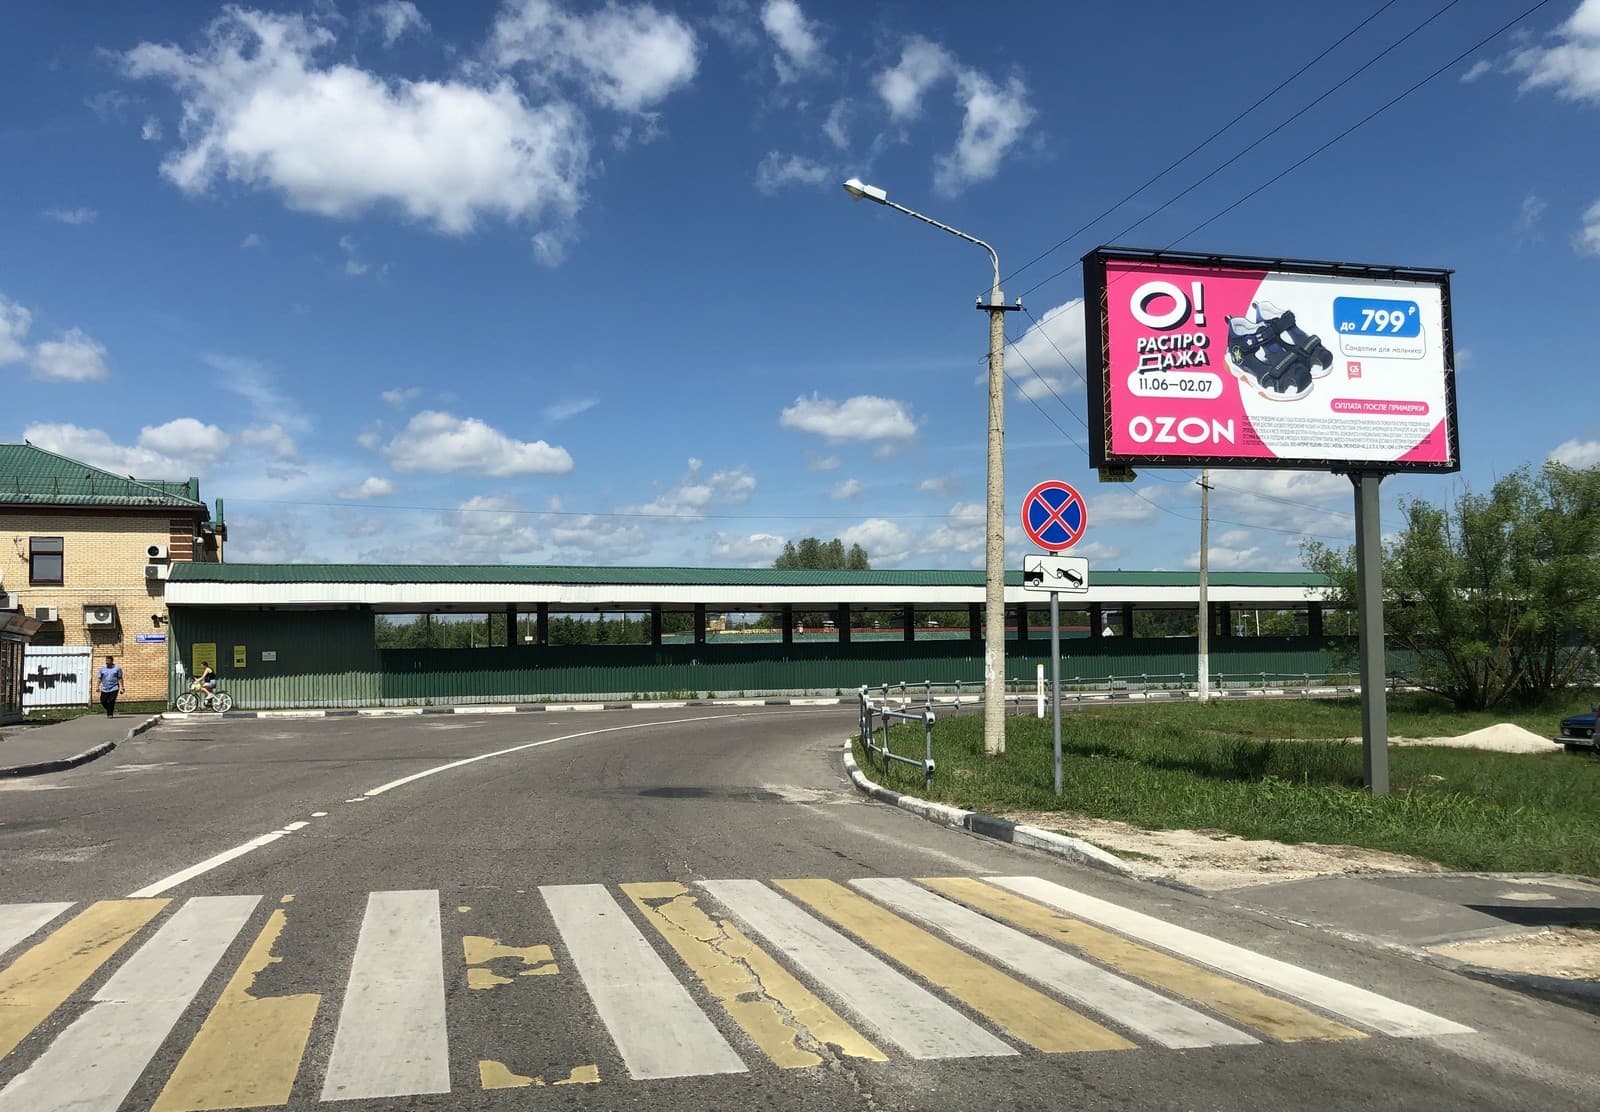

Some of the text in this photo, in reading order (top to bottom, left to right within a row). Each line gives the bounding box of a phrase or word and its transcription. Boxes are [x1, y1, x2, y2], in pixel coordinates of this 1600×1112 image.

[1340, 321, 1356, 332] до
[1137, 332, 1208, 353] РАСПРО
[1136, 350, 1208, 372] ДАЖА
[1334, 402, 1425, 412] ОПЛАТА ПОСЛЕ ПРИМЕРКИ
[1128, 415, 1235, 445] OZON
